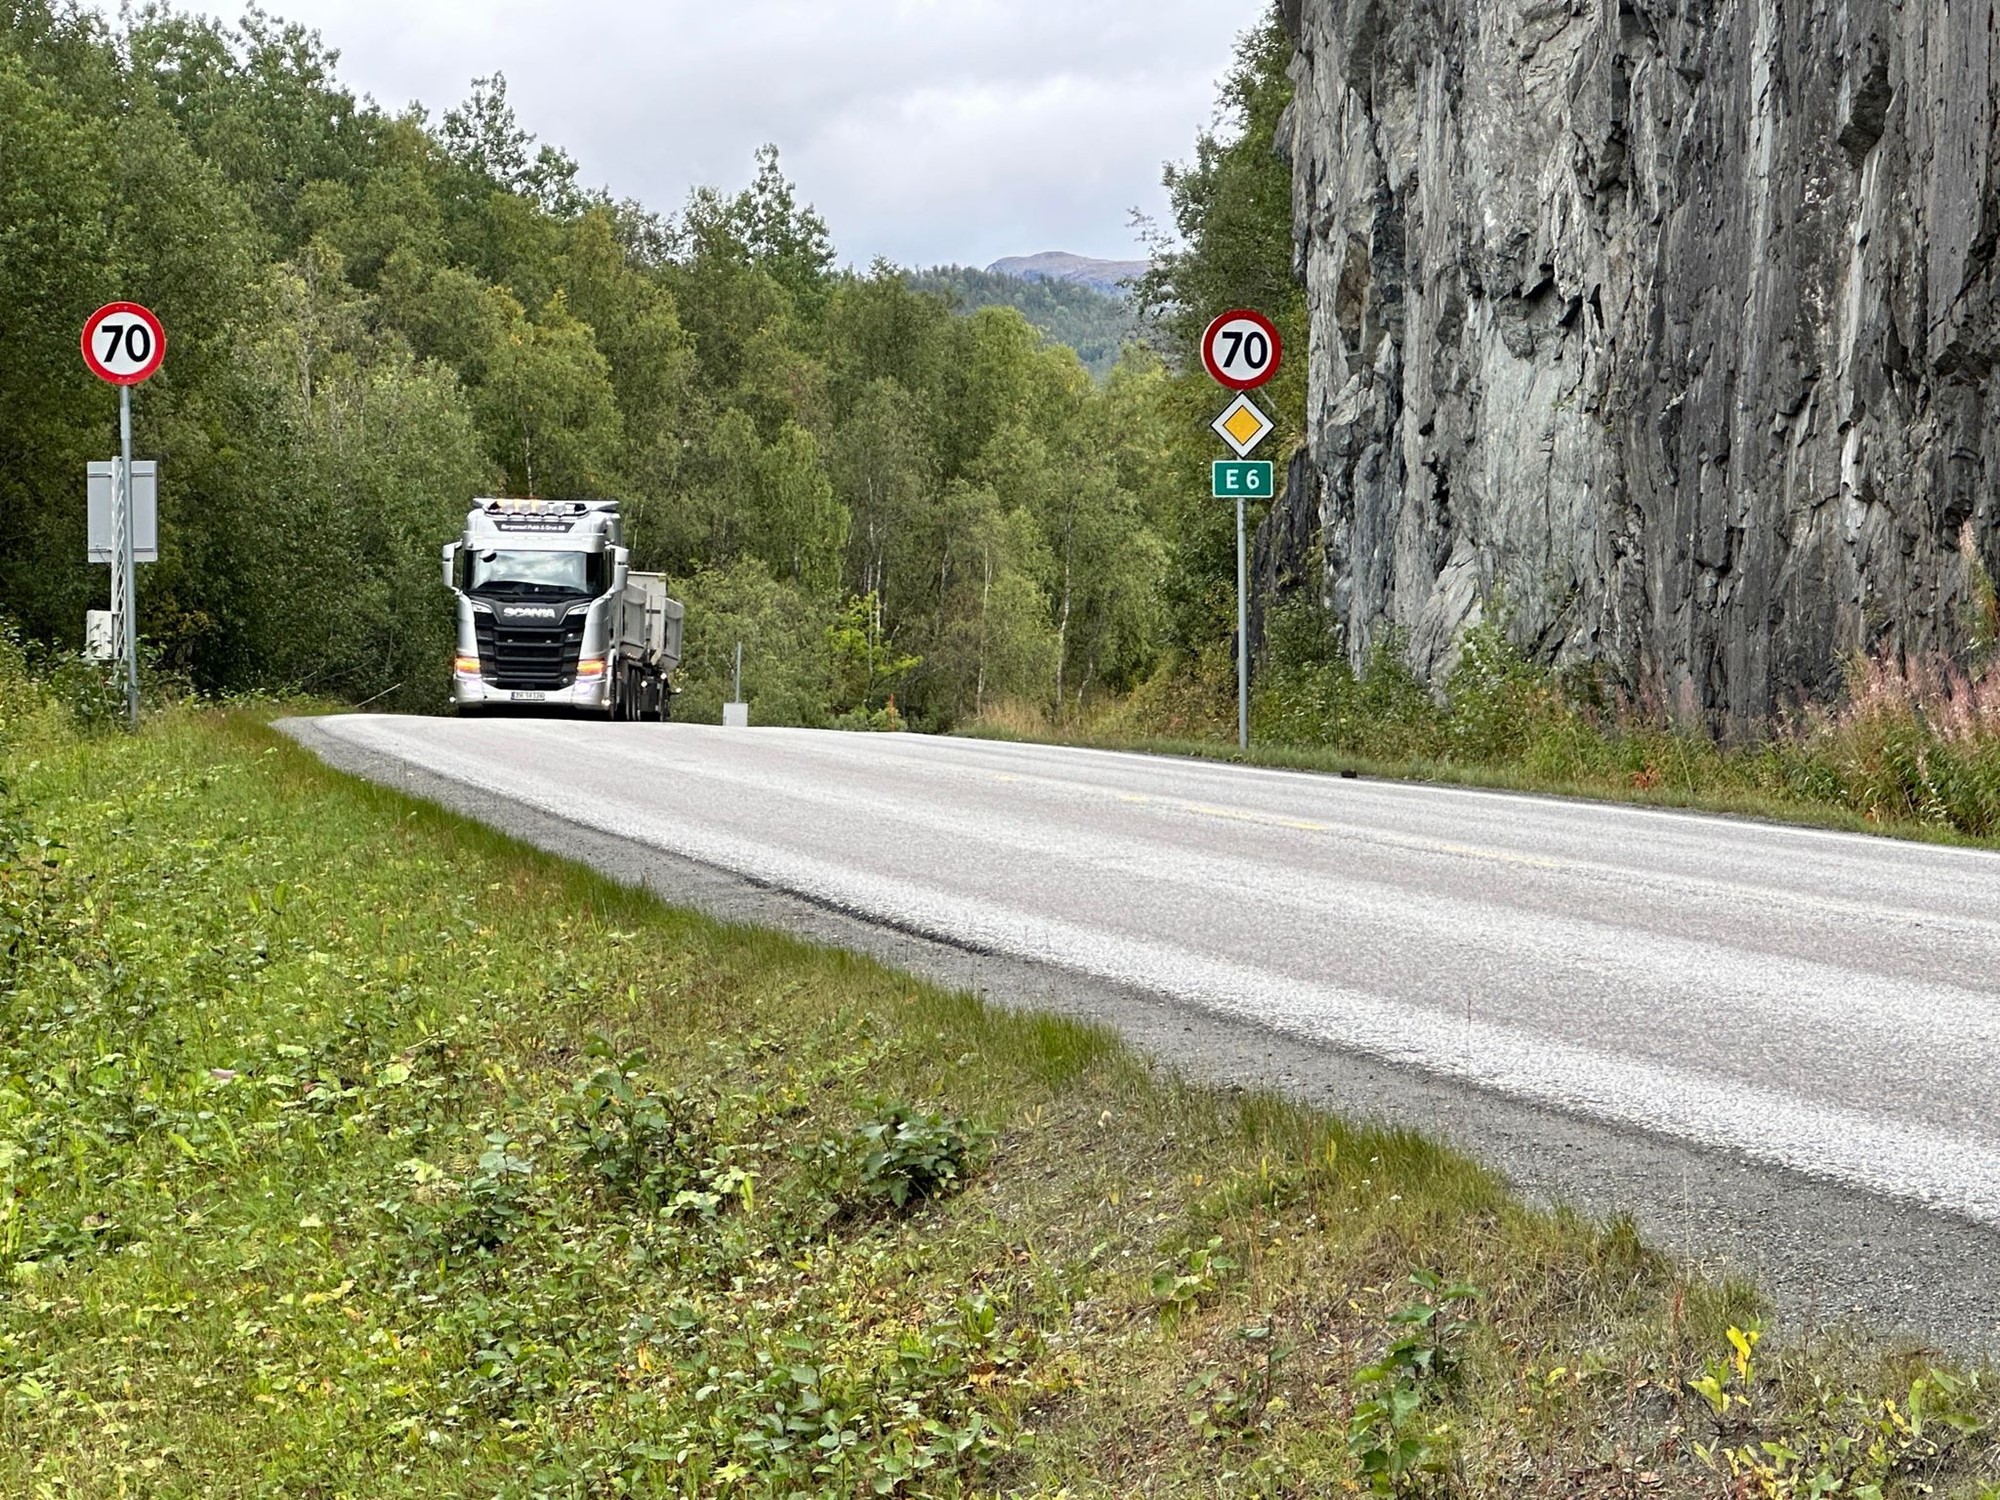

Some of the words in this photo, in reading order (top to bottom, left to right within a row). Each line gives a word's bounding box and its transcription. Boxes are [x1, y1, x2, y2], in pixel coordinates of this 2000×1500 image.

[101, 324, 150, 363] 70
[1222, 331, 1268, 369] 70
[1226, 469, 1239, 489] E
[1246, 469, 1260, 489] 6
[503, 607, 556, 619] SCANIA
